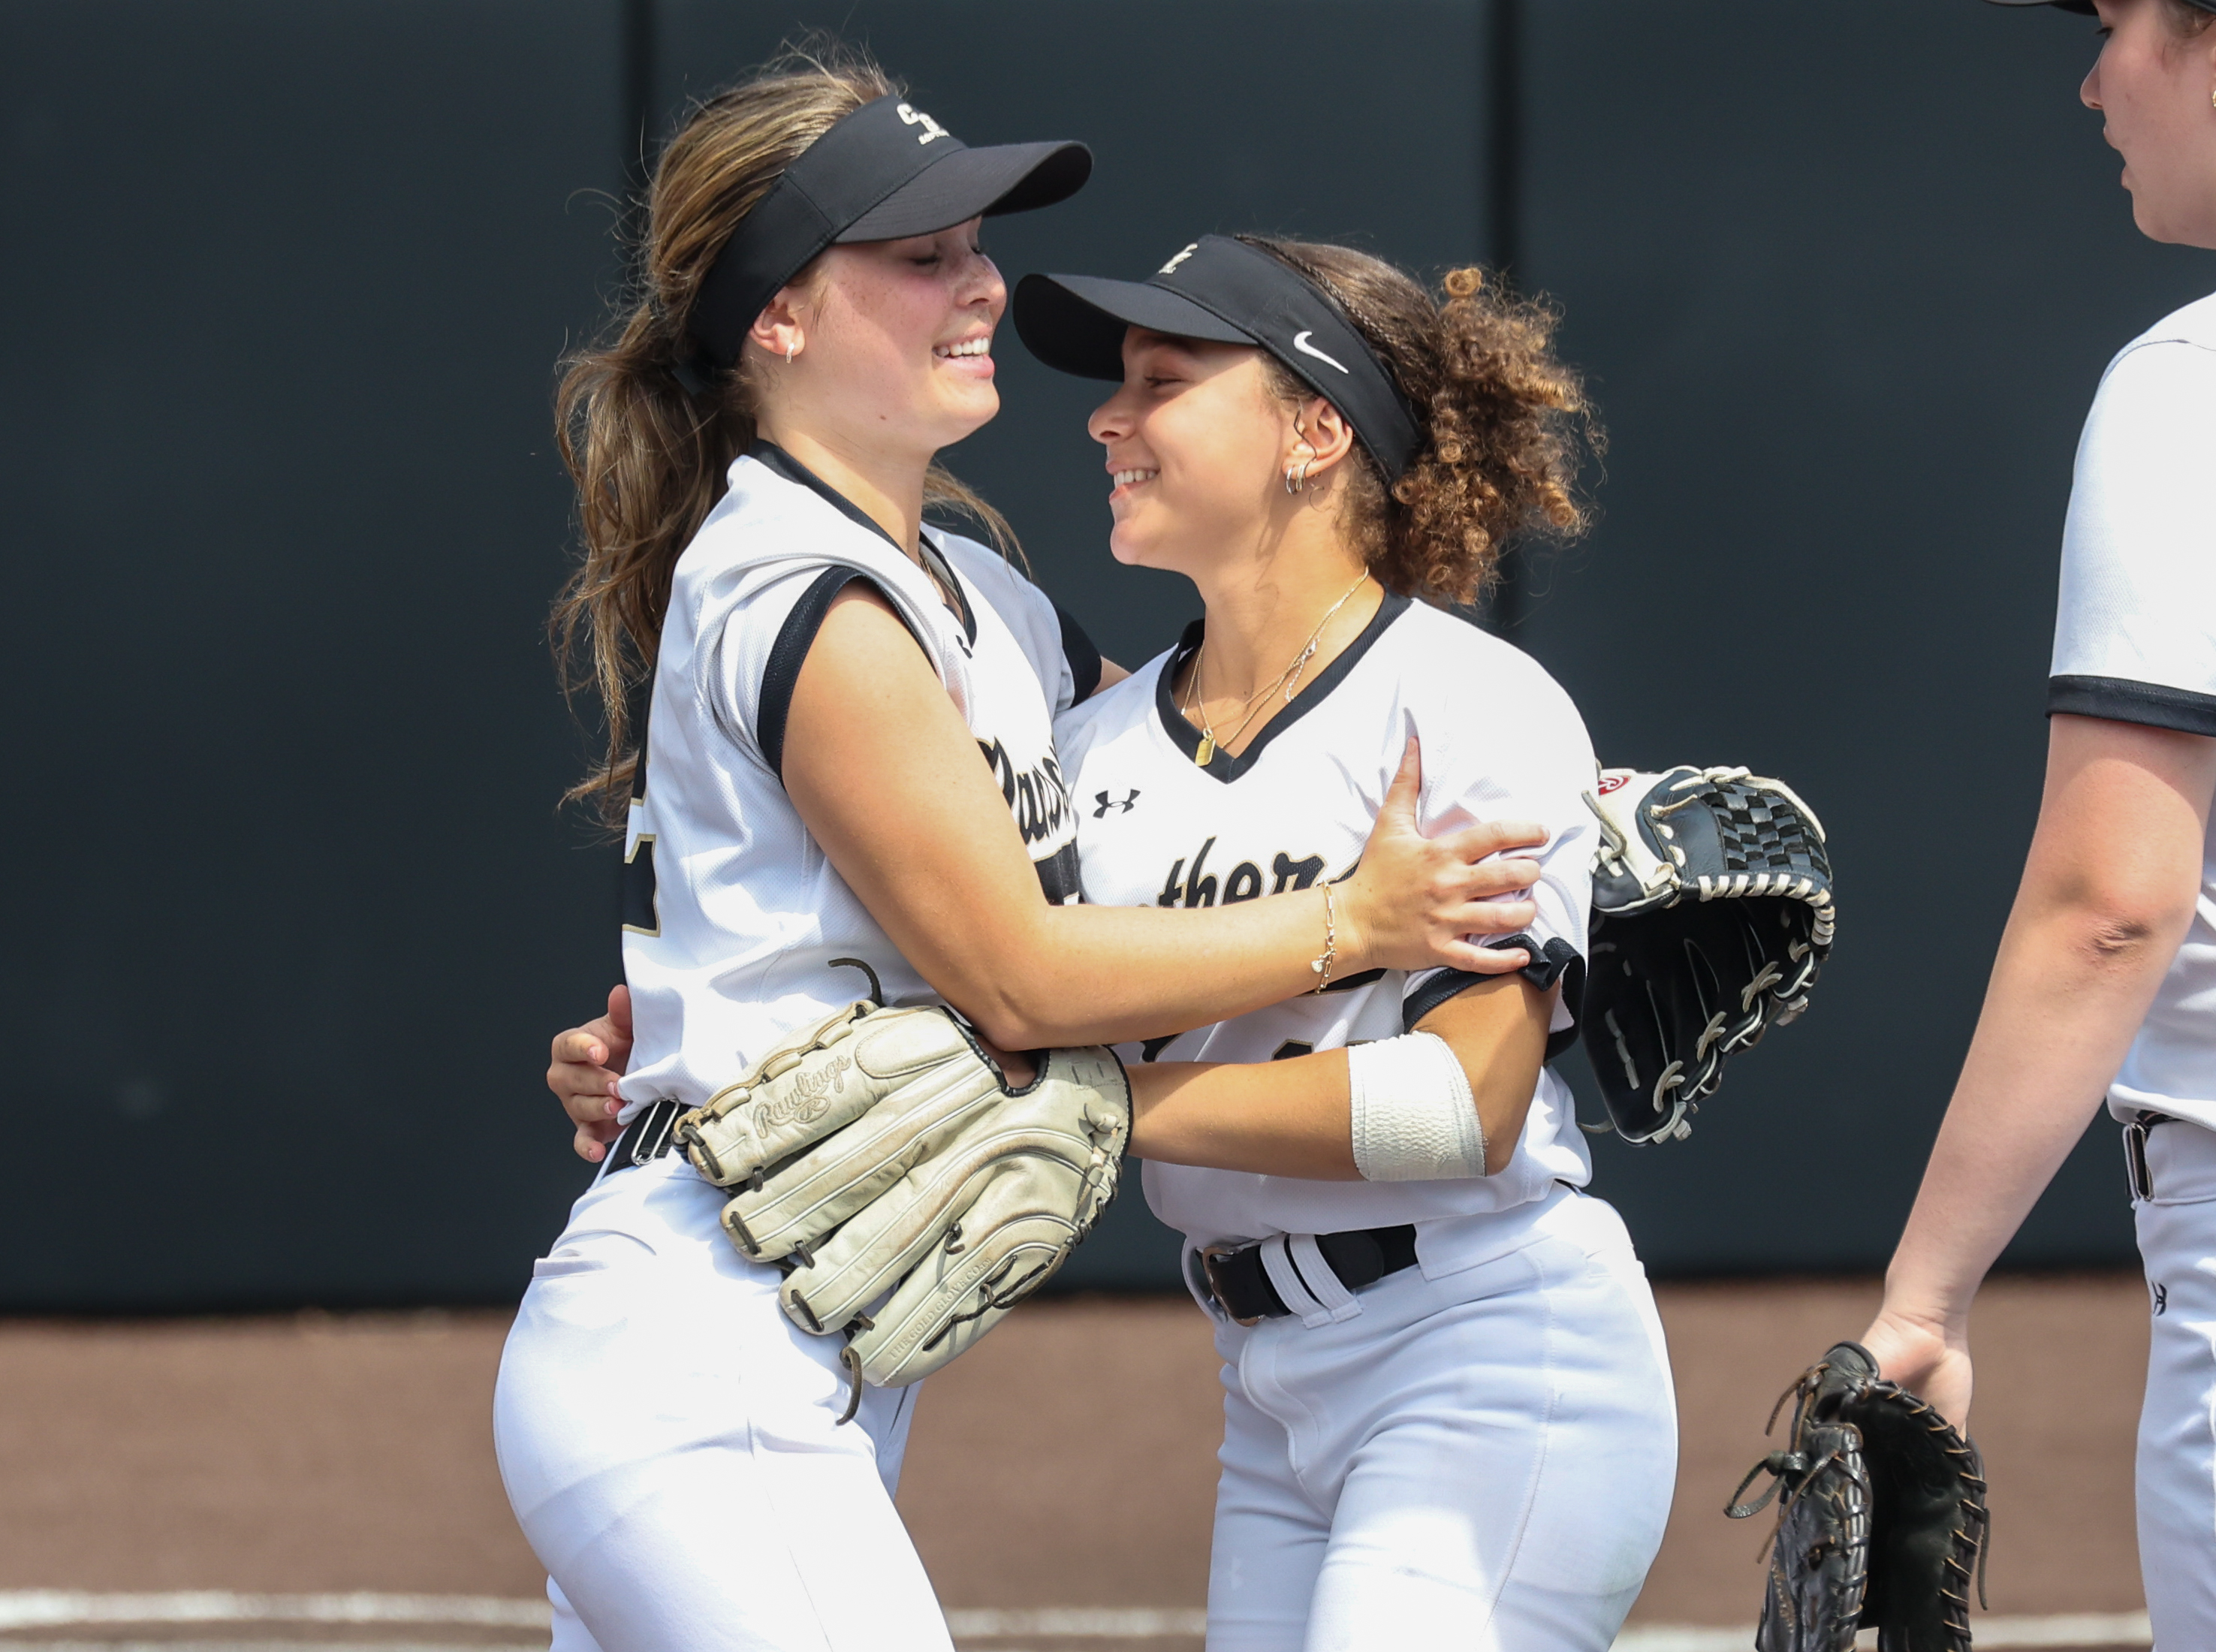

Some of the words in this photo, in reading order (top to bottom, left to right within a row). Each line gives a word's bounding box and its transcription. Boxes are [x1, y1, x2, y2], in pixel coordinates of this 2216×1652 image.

[753, 1055, 851, 1139] Rawlings
[888, 1337, 910, 1360] THE
[909, 1312, 935, 1339] GOLD
[935, 1280, 966, 1313] GLOVE
